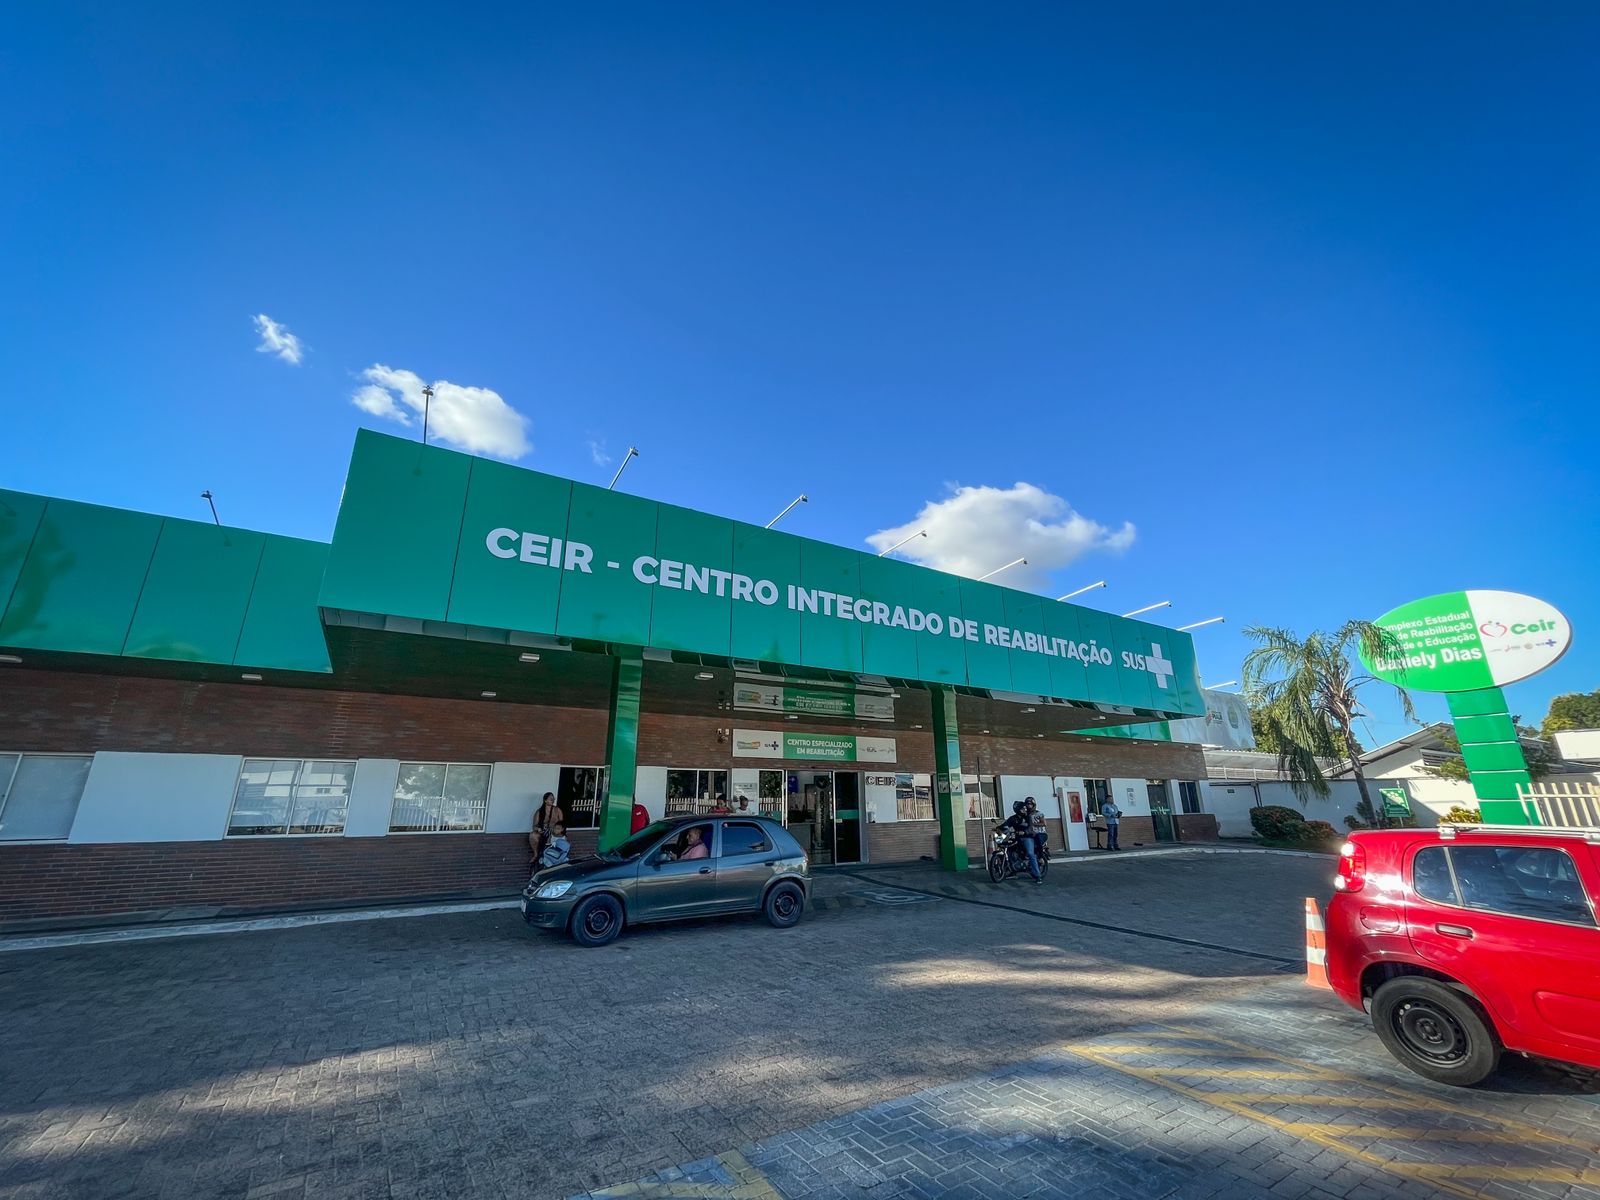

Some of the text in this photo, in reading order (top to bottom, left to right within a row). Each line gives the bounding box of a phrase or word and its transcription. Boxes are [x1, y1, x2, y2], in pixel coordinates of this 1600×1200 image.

[486, 527, 1113, 668] CEIR - CENTRO INTEGRADO DE REABILITAÇÃO
[1380, 611, 1470, 633] omplexo Estadual
[1510, 619, 1555, 635] Ceir
[1397, 622, 1473, 640] de Reabilitação
[1425, 633, 1477, 647] Educação
[1121, 650, 1146, 671] SUS
[1440, 646, 1483, 663] Dias
[787, 738, 853, 748] CENTRO ESPECIALIZADO
[865, 776, 896, 786] CEIR
